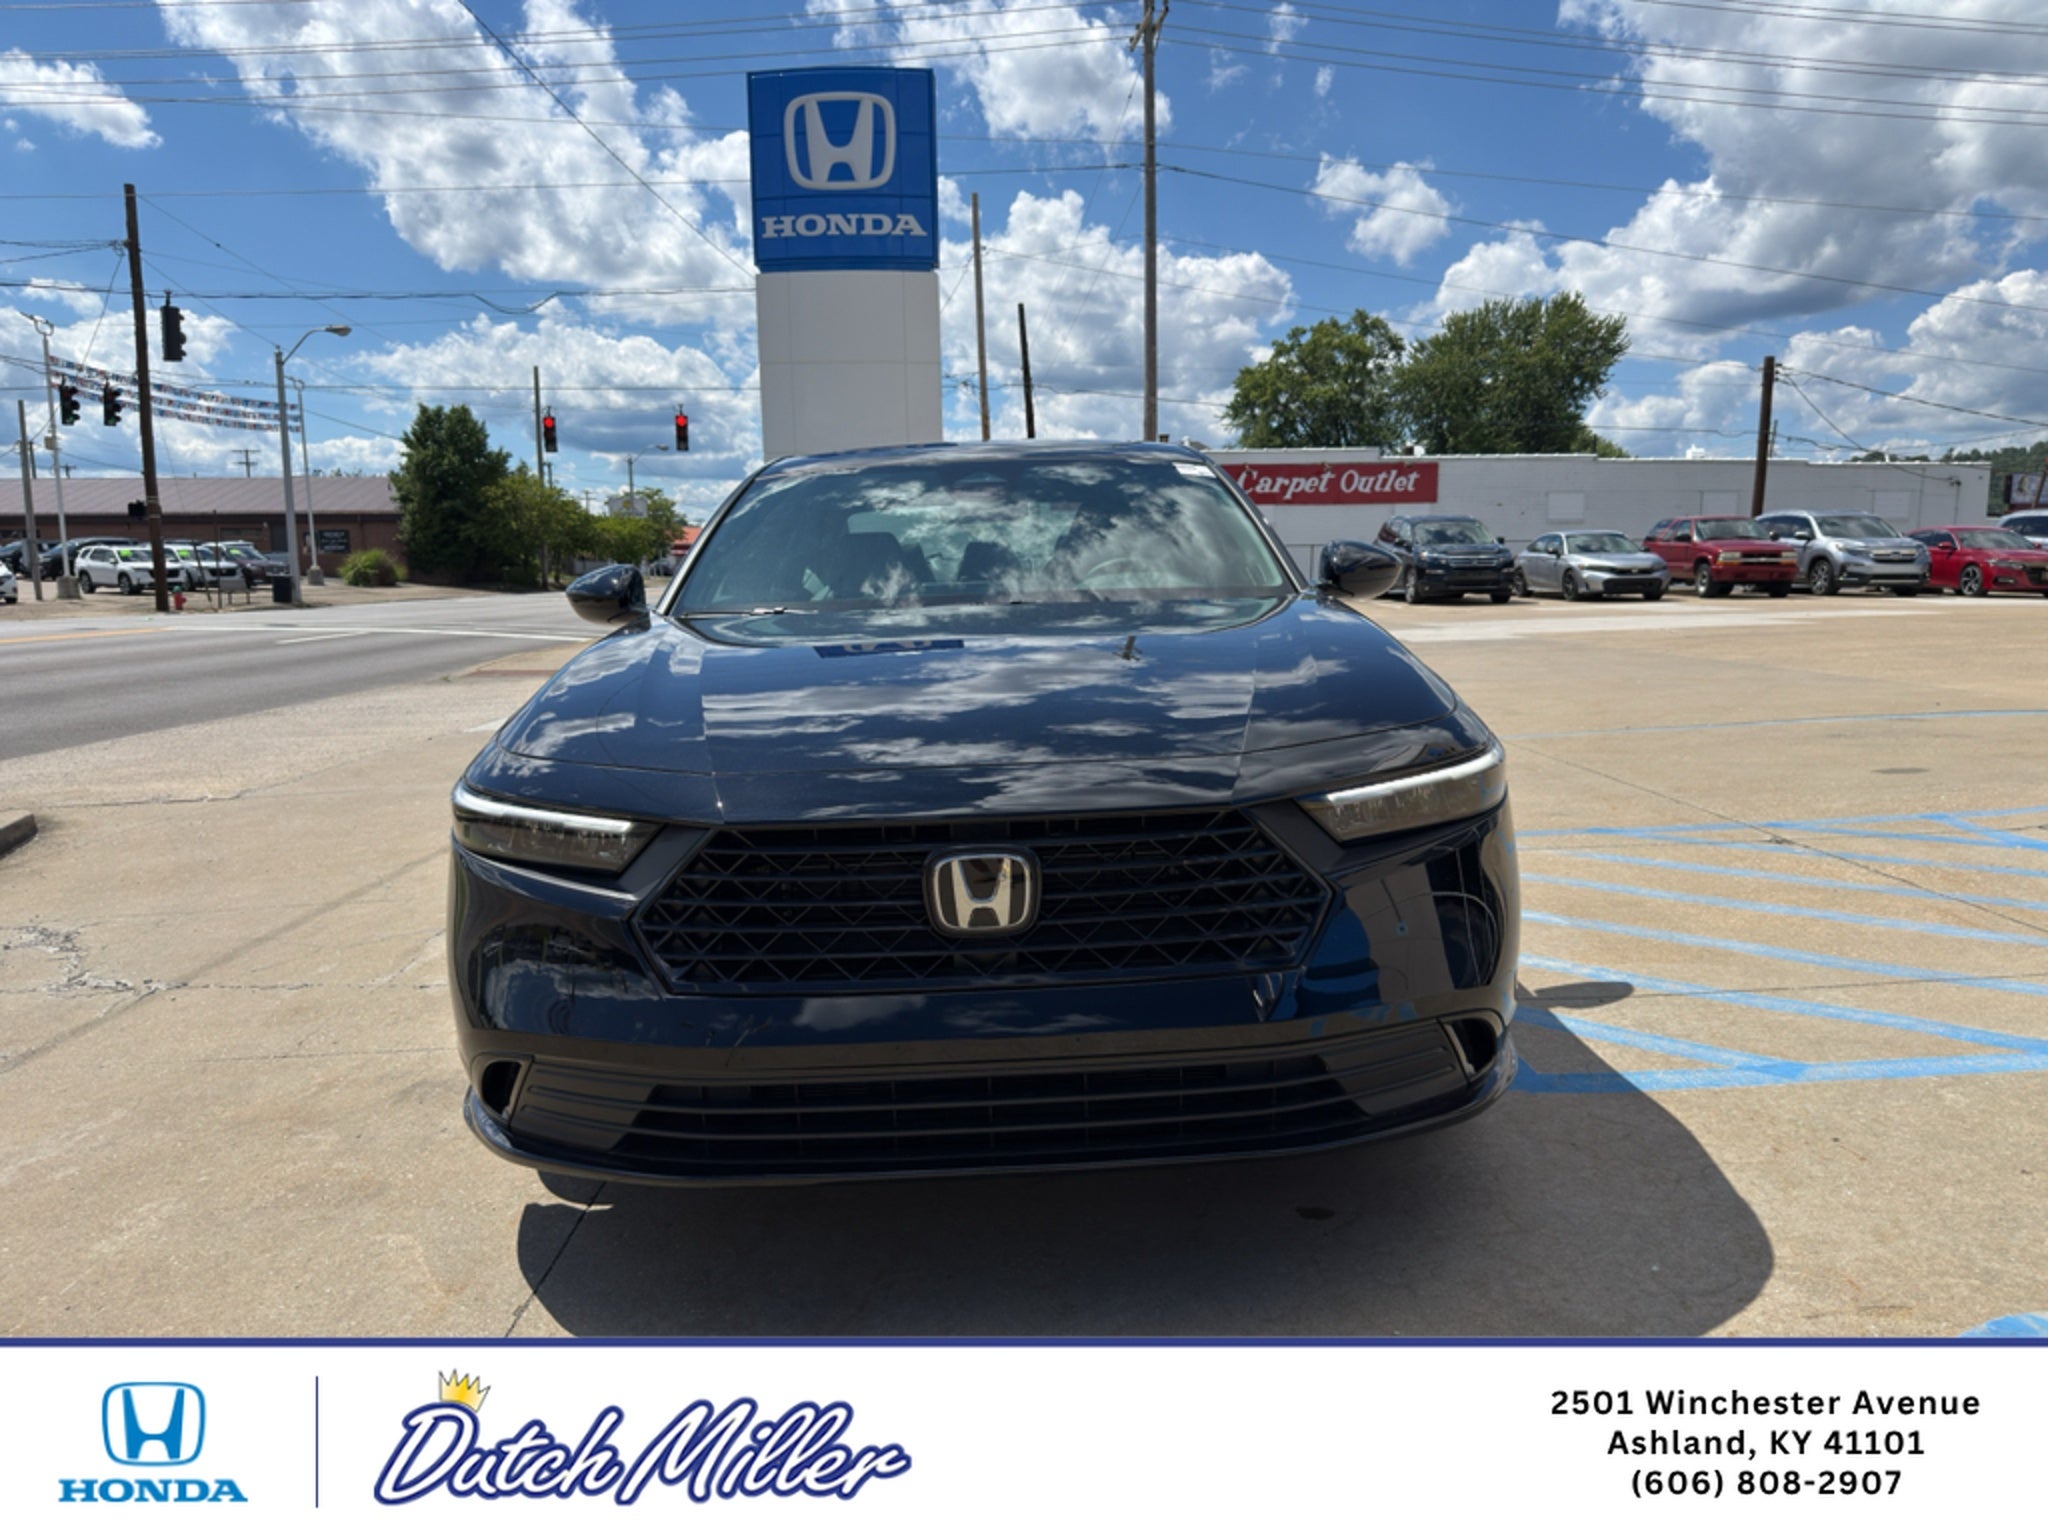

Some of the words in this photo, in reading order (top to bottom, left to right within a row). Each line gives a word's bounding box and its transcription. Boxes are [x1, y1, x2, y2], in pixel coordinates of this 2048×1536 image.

[761, 213, 928, 239] HONDA
[1237, 470, 1336, 500] Carpet
[1340, 469, 1420, 494] Outlet
